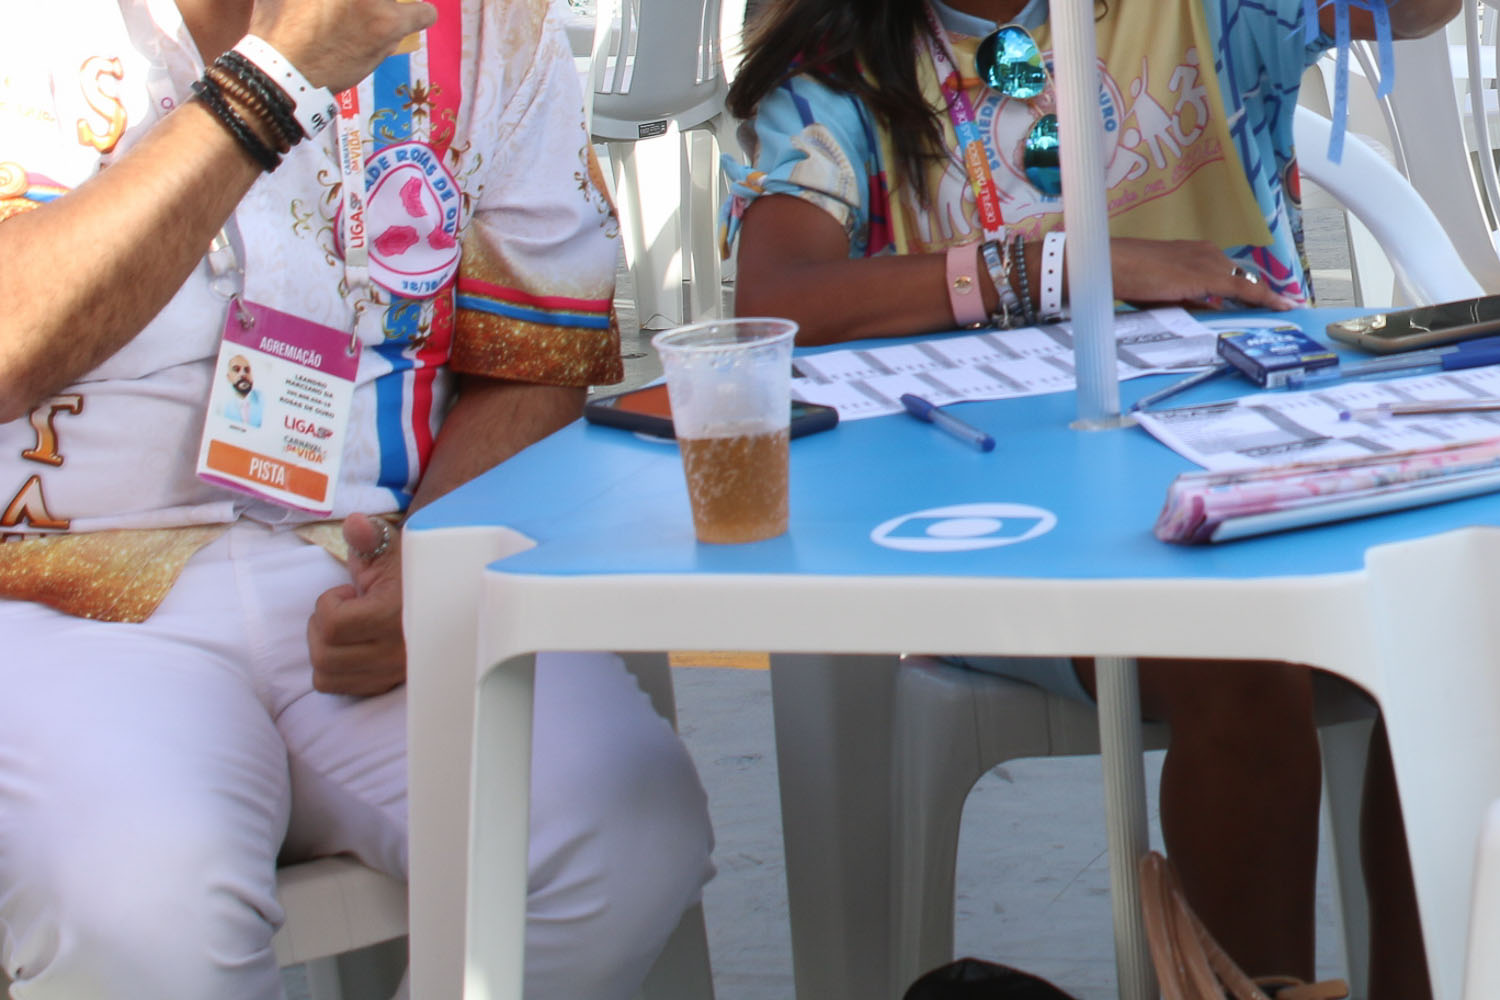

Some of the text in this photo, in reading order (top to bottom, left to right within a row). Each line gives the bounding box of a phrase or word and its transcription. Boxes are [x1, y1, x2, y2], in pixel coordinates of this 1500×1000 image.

[395, 148, 437, 176] ROSAS
[433, 175, 456, 203] DE
[259, 336, 323, 368] AGREMIAÇÃO
[248, 457, 286, 486] PISTA
[297, 448, 324, 465] VIDA
